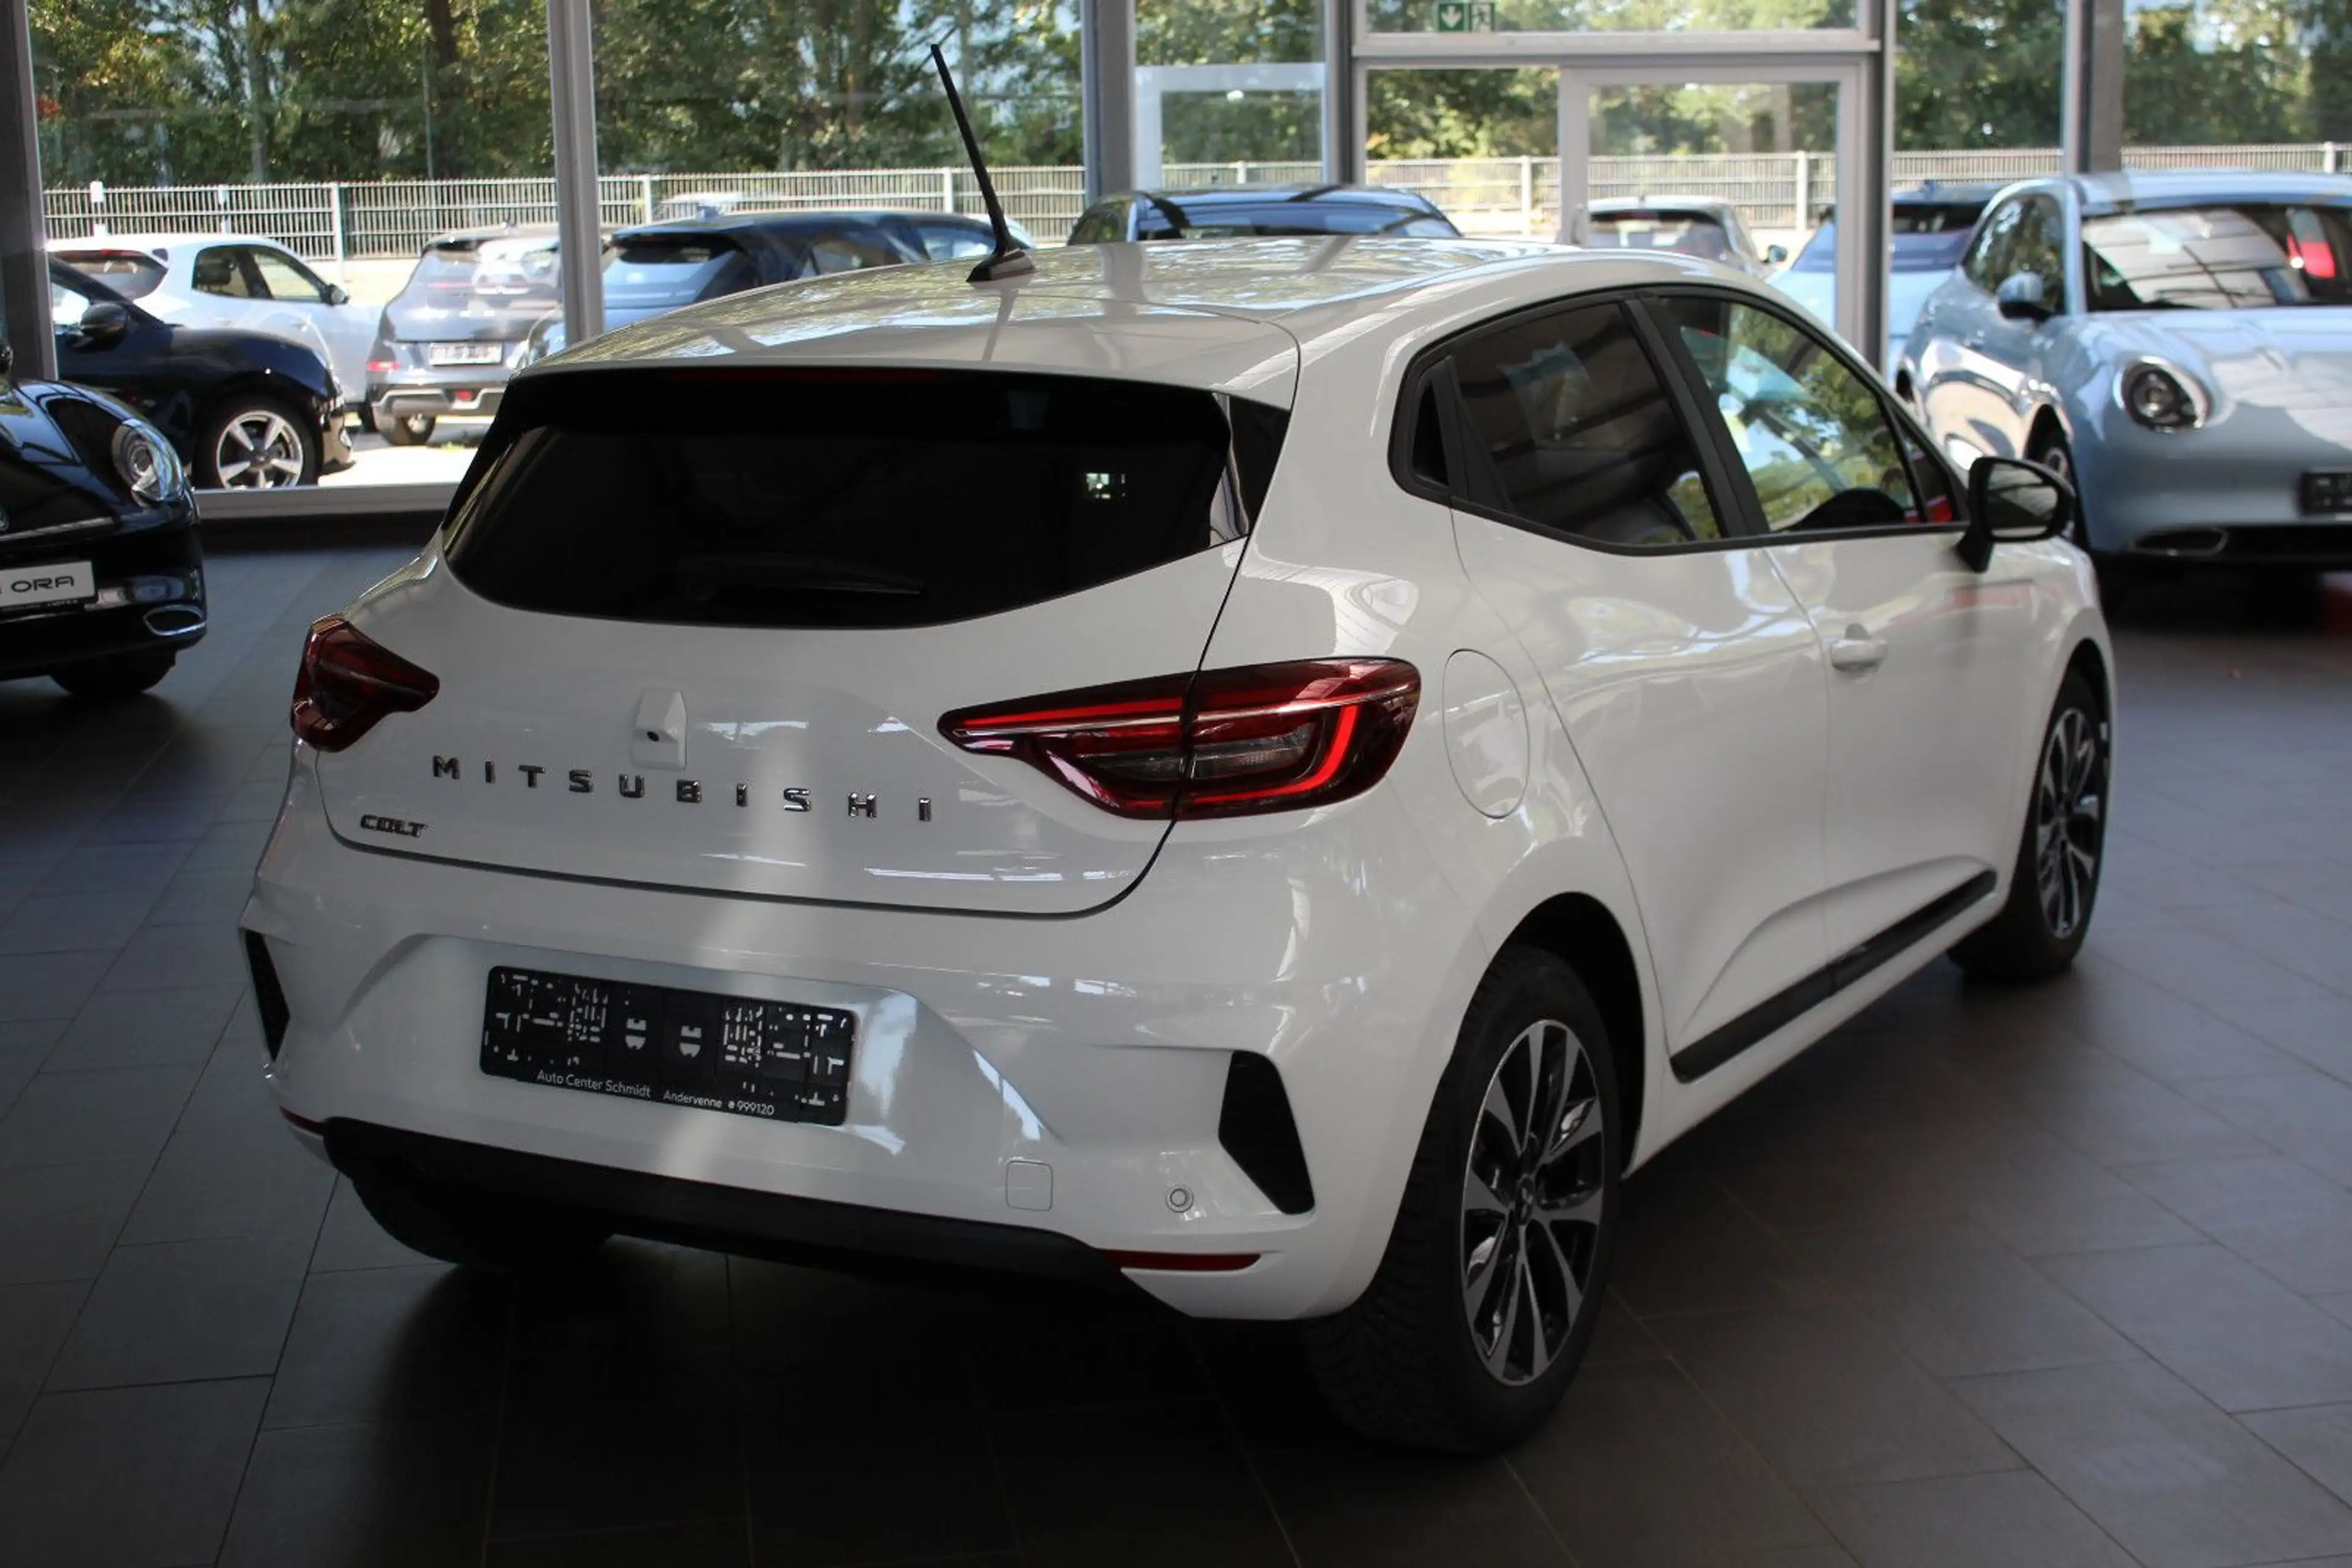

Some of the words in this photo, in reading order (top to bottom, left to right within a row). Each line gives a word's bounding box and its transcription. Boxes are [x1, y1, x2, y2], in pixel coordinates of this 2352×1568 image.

[11, 576, 74, 592] ORA
[432, 754, 932, 822] MITSUBISHI
[360, 814, 429, 838] COLT
[537, 1069, 564, 1085] Auto
[565, 1074, 603, 1090] Center
[605, 1079, 651, 1098] Schmidt
[736, 1100, 775, 1116] 999120
